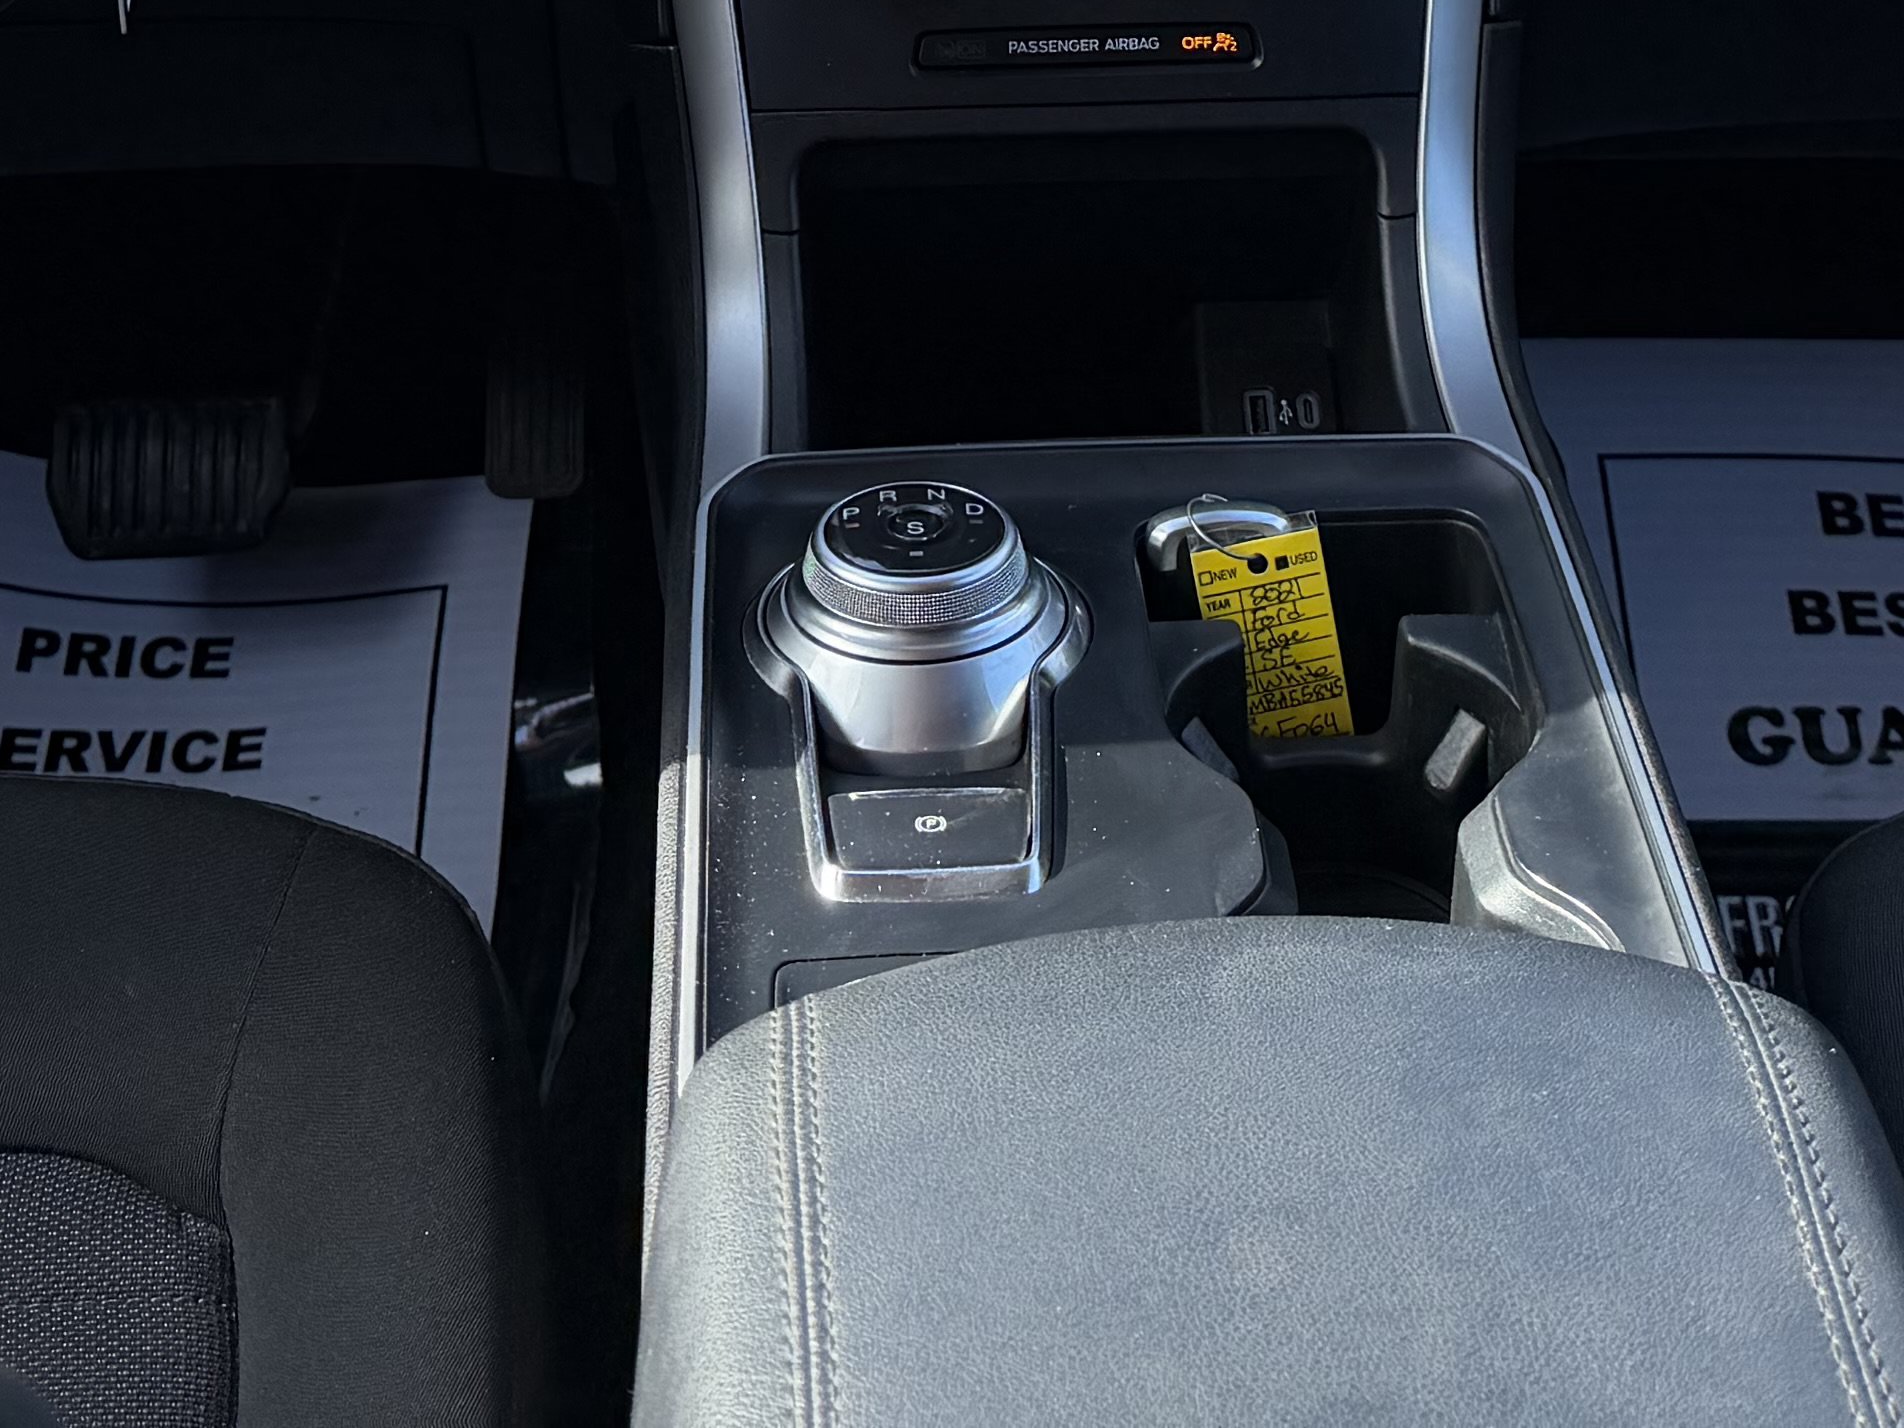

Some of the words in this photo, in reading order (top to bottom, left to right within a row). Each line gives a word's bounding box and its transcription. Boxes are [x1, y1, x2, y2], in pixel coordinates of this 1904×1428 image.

[1008, 39, 1100, 55] PASSENGER
[1104, 37, 1160, 51] AIRBAG
[1181, 36, 1212, 50] OFF
[879, 490, 898, 502] R
[927, 488, 946, 501] N
[842, 507, 860, 521] P
[965, 503, 984, 516] D
[907, 521, 925, 535] S
[1290, 551, 1318, 566] USED
[1213, 567, 1238, 582] NEW
[1206, 598, 1231, 612] YEAR
[1252, 602, 1306, 630] Ford
[14, 624, 235, 682] PRICE
[1261, 646, 1296, 672] SE
